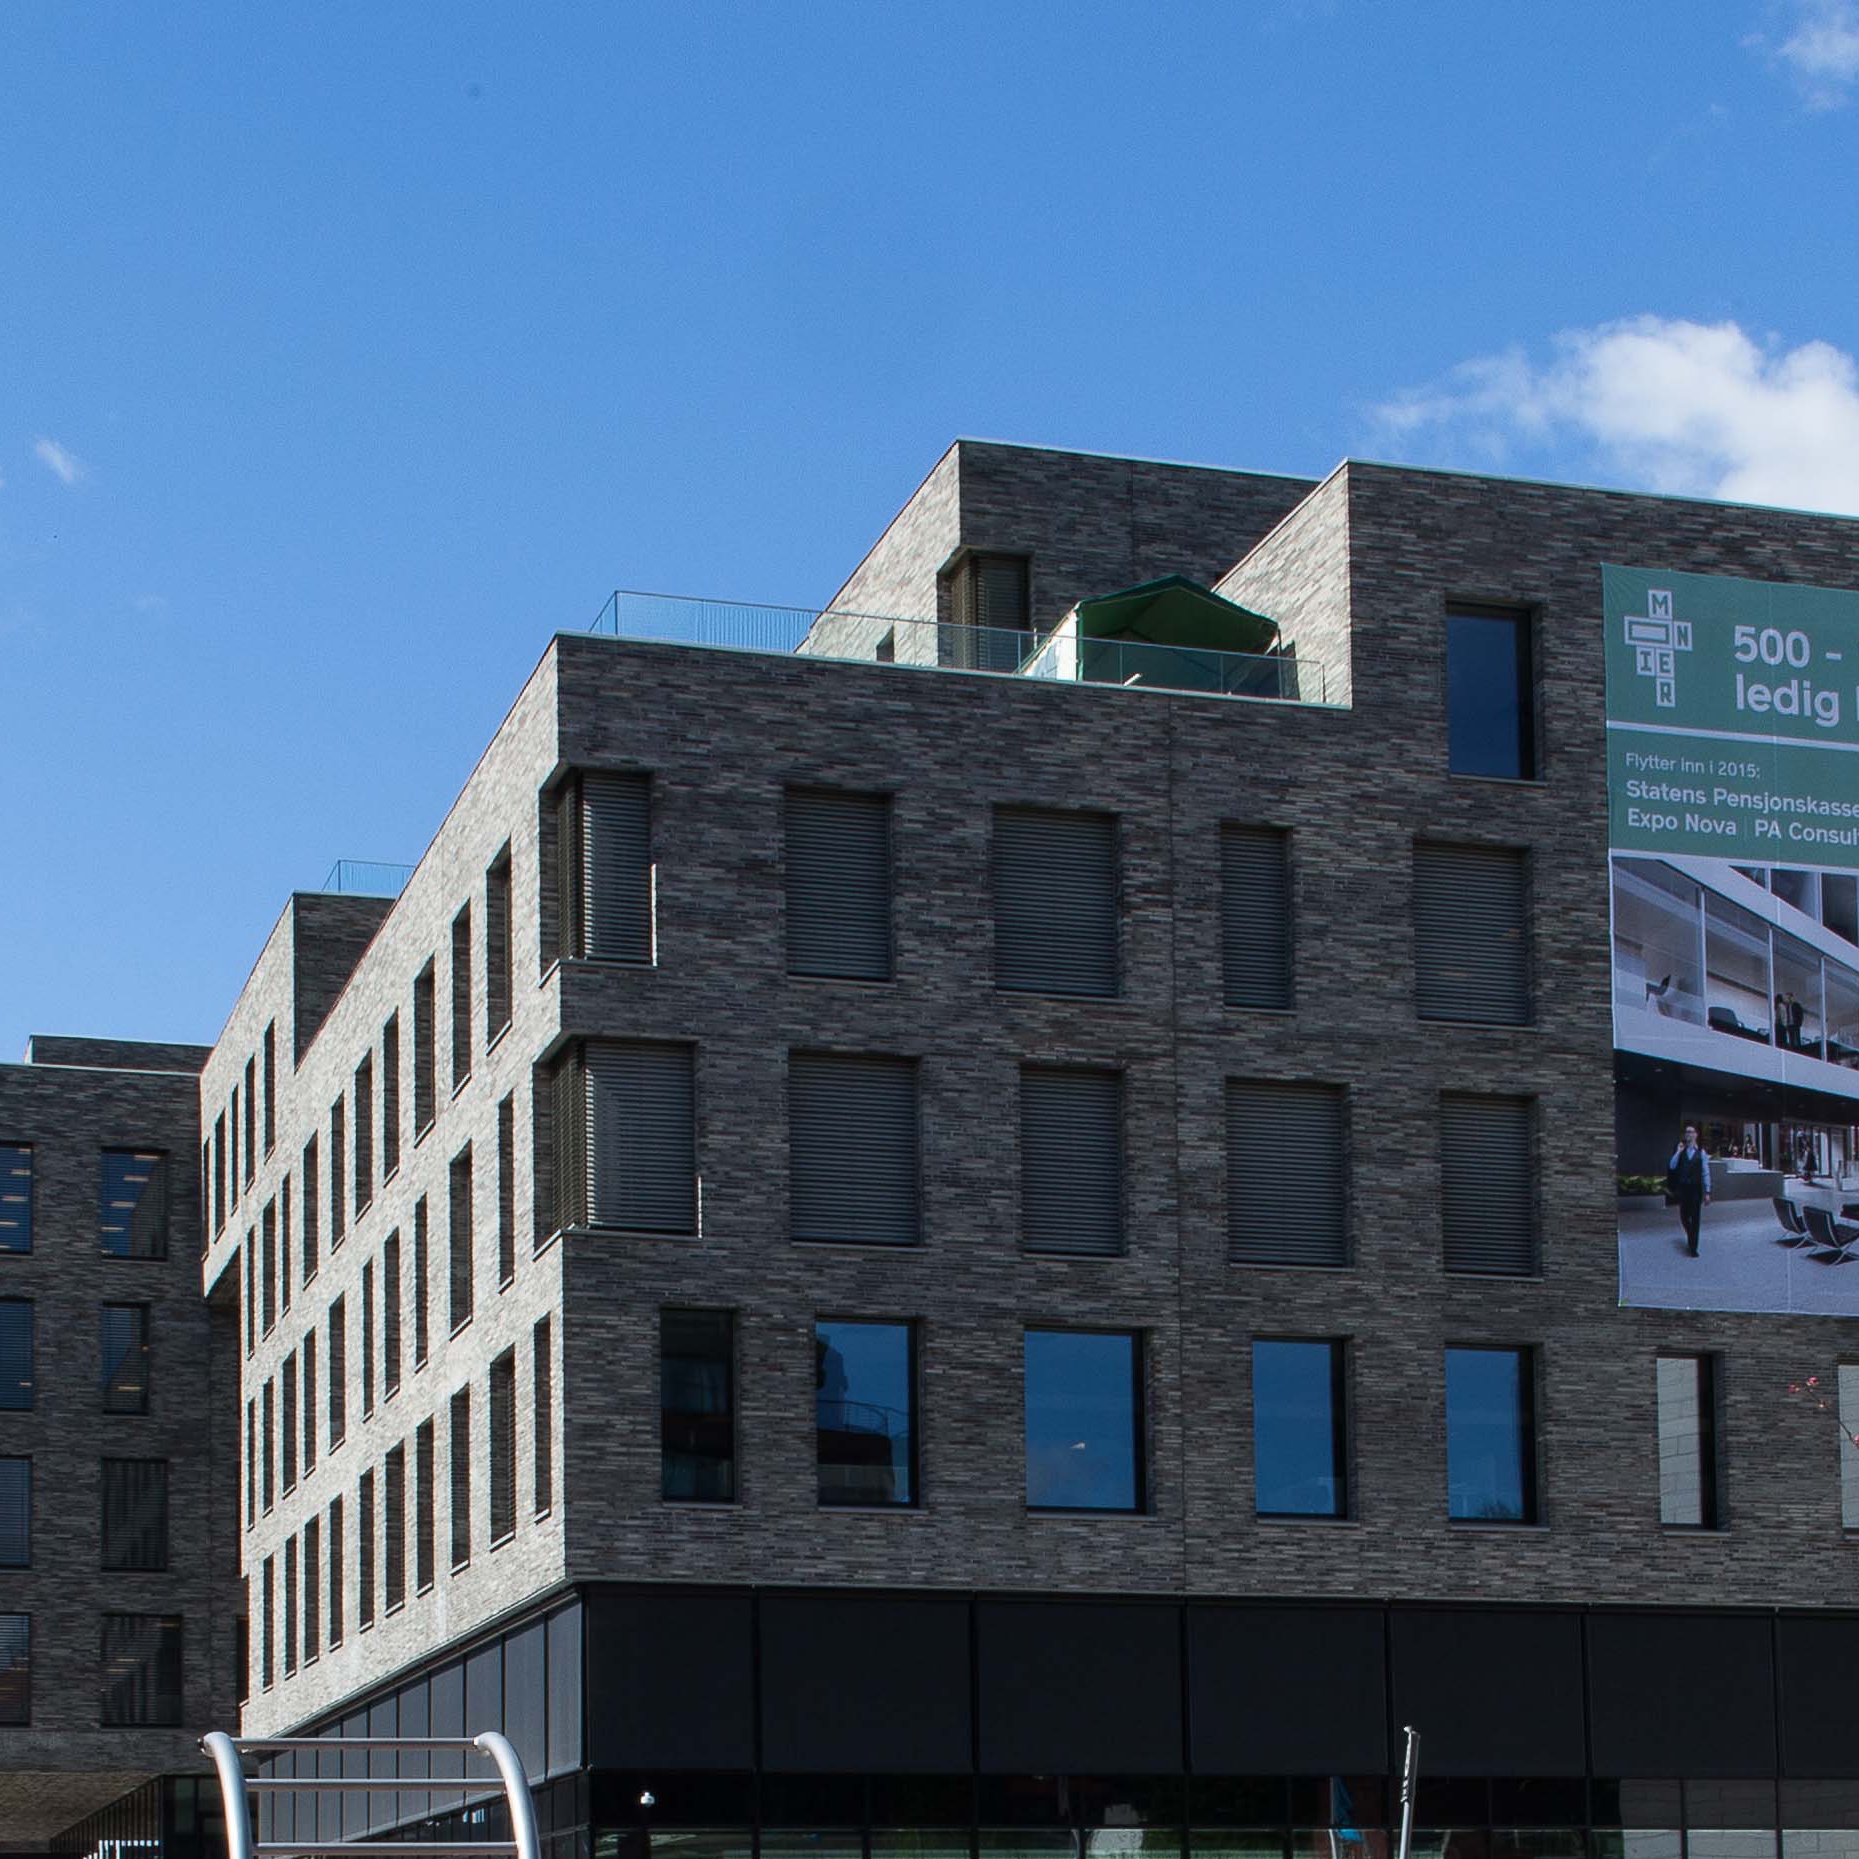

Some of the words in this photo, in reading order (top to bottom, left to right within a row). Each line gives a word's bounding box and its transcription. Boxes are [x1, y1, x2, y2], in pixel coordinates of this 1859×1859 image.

[1734, 624, 1810, 666] 500
[1736, 673, 1839, 727] ledig
[1626, 752, 1676, 771] Flytter
[1718, 761, 1760, 779] 2015:
[1626, 780, 1706, 804] Statens
[1628, 808, 1678, 832] Expo
[1685, 813, 1737, 835] Nova
[1755, 819, 1782, 839] PA
